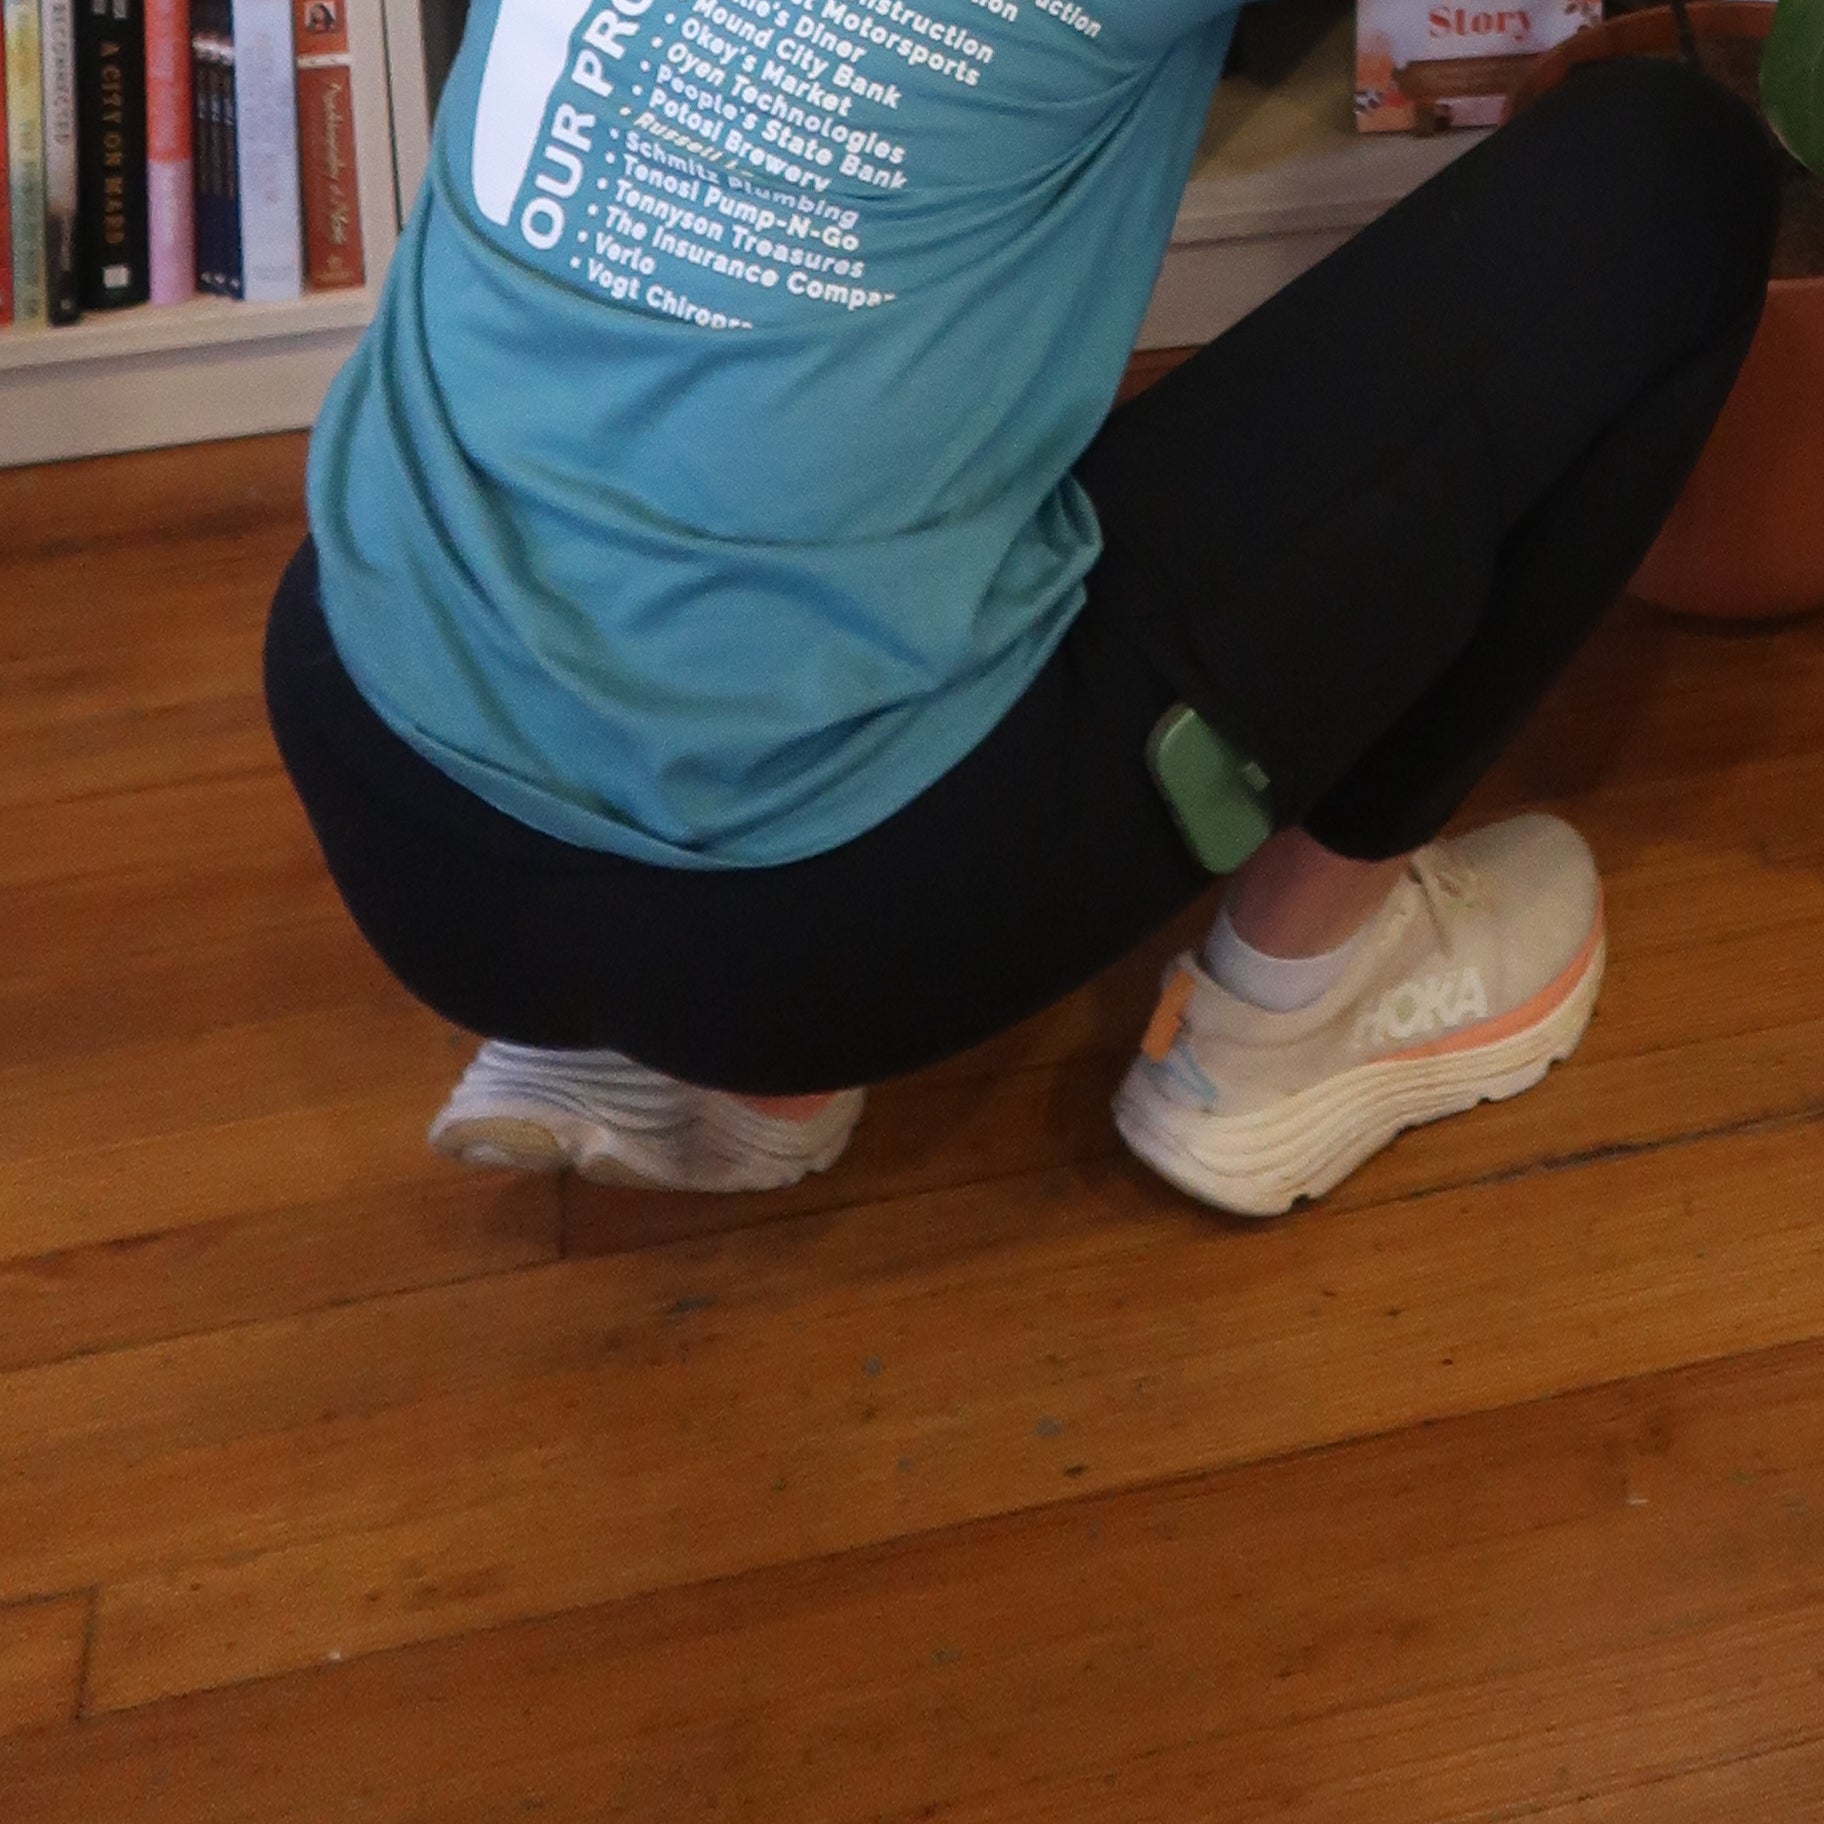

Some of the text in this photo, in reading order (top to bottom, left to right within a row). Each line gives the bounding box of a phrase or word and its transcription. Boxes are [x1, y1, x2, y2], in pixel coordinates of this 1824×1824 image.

[793, 14, 867, 63] Diner
[1430, 5, 1530, 41] Story
[667, 42, 905, 177] Oyen Technologies
[675, 17, 852, 117] Okey's Market
[776, 37, 830, 80] City
[832, 63, 902, 109] Bank
[521, 107, 596, 250] OUR
